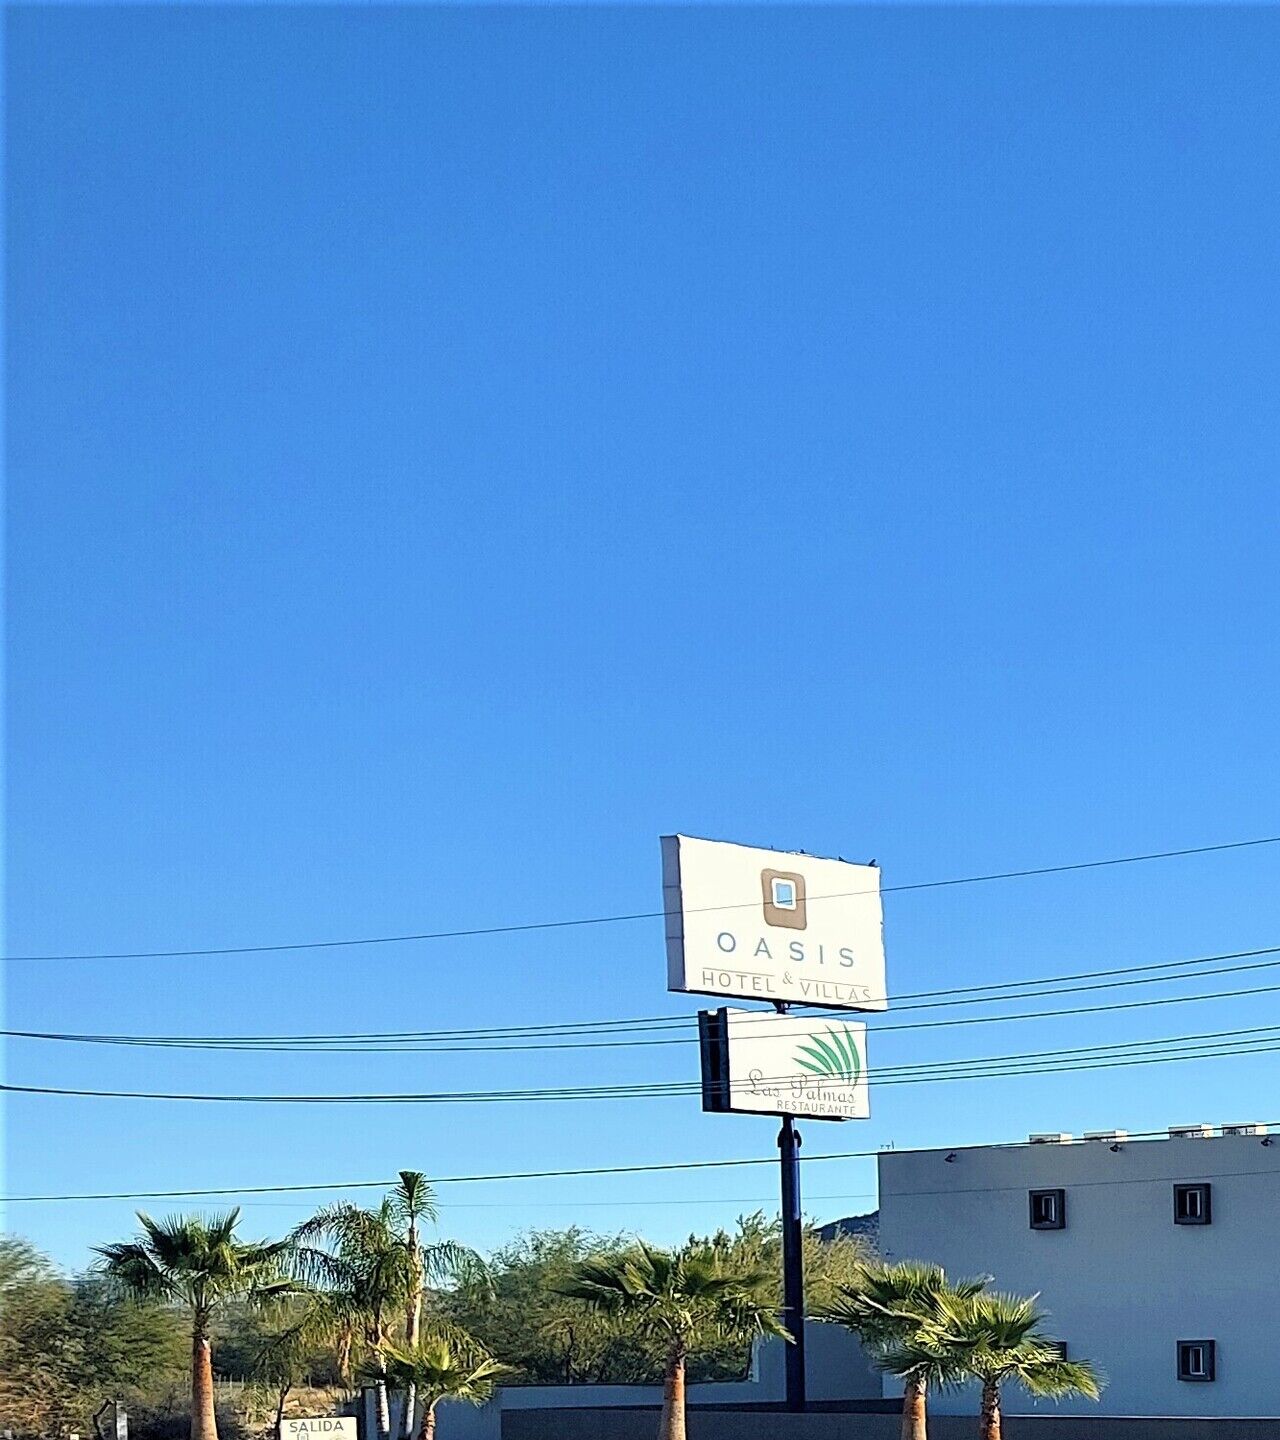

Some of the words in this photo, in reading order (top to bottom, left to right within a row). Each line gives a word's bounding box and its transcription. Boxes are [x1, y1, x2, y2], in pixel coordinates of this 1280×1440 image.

[717, 931, 855, 968] OASIS
[702, 970, 776, 993] HOTEL
[782, 971, 794, 985] &
[799, 981, 872, 1001] VILLAS
[744, 1068, 780, 1097] Las
[790, 1072, 856, 1104] Palmas
[776, 1099, 856, 1116] RESTAURANTE
[289, 1420, 344, 1433] SALIDA
